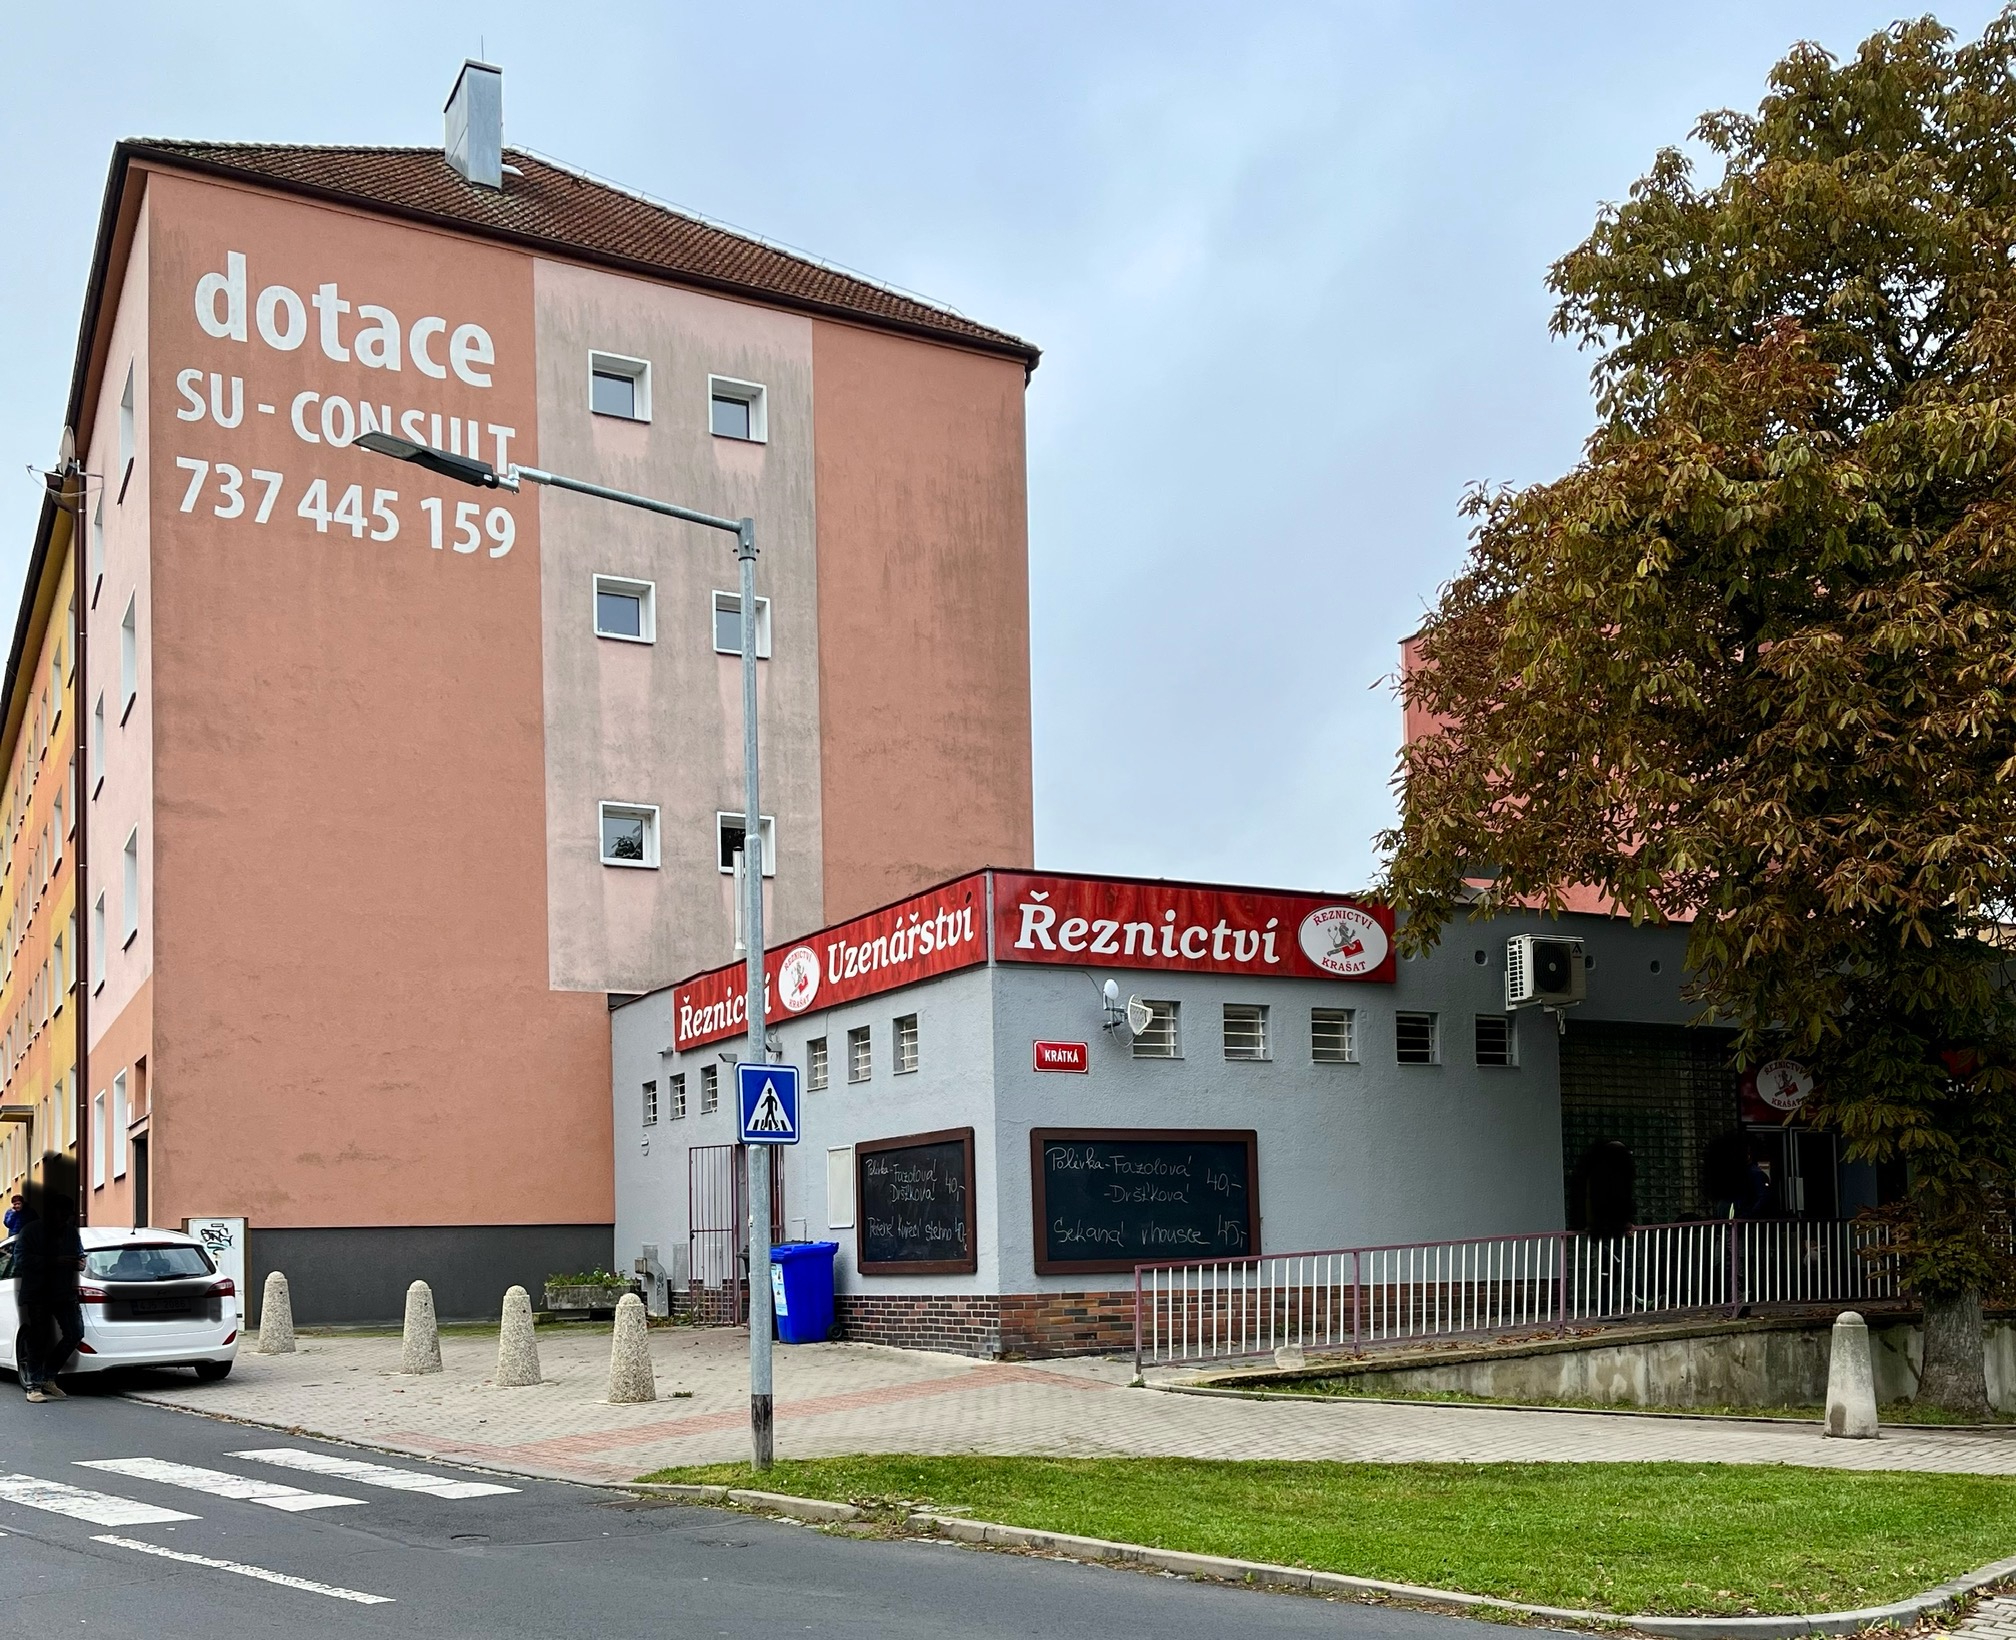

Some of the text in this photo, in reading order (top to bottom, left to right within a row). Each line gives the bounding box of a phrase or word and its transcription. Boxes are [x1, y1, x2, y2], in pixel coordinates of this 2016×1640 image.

[194, 250, 495, 388] dotace
[176, 368, 245, 429] SU
[176, 456, 516, 559] 737 445 159
[1014, 890, 1281, 964] Řeznictví
[1313, 910, 1374, 930] ŘEZNICTVÍ
[1321, 957, 1366, 972] KRAŠAT
[1044, 1048, 1079, 1063] KRÁTKÁ
[1053, 1216, 1125, 1248] Sekaná
